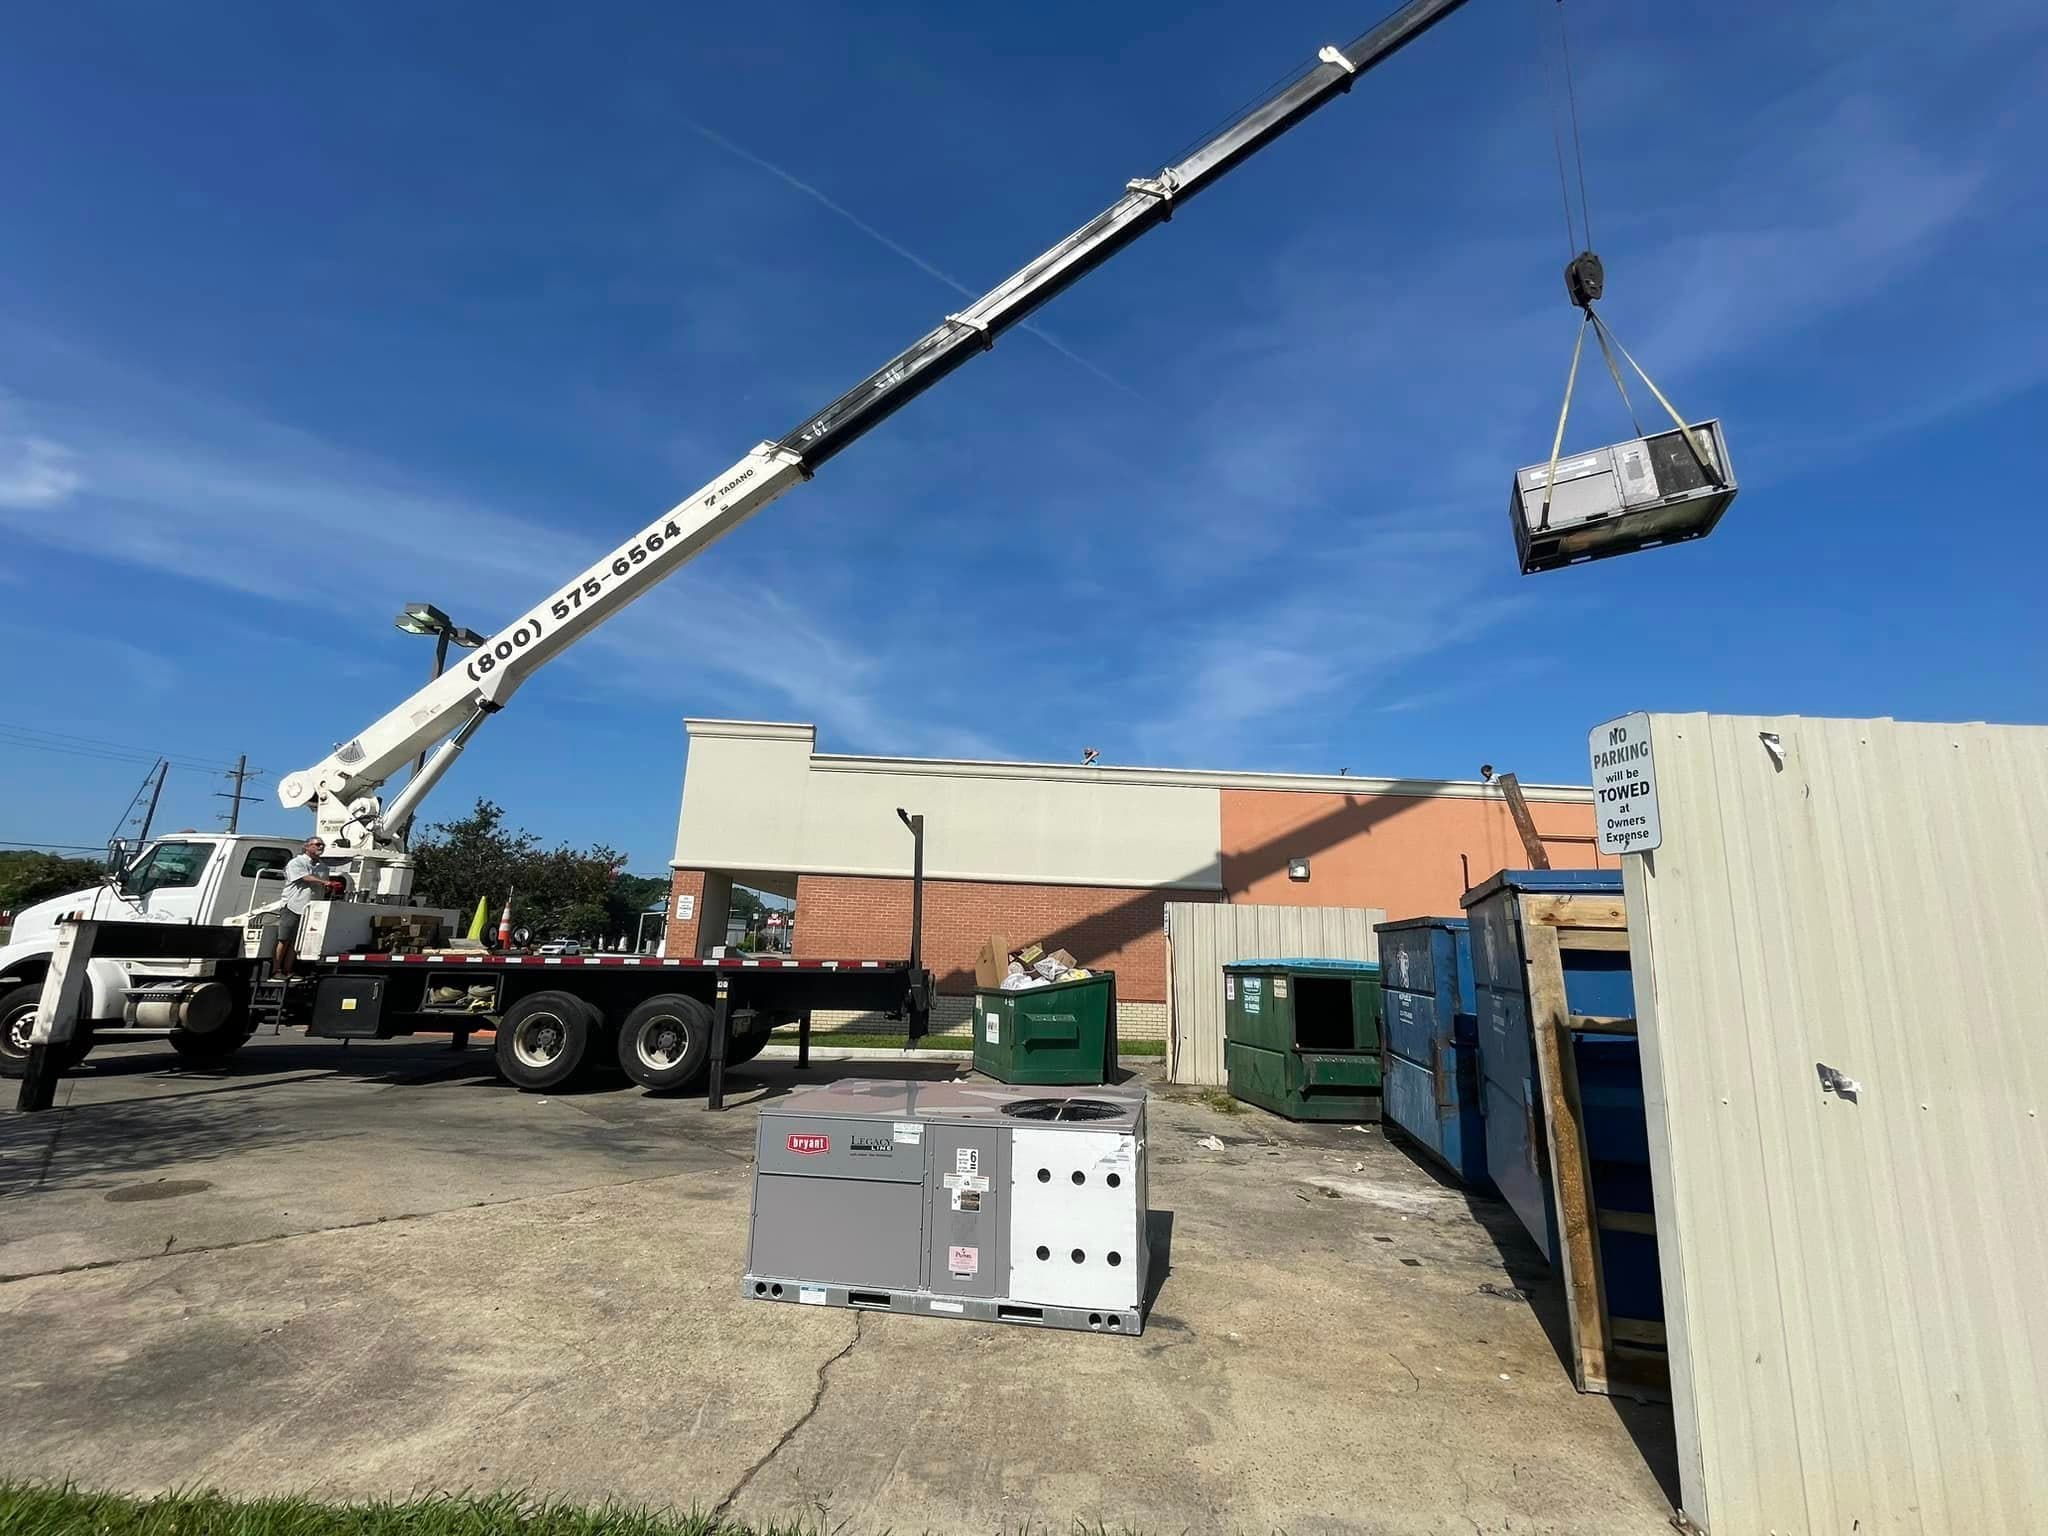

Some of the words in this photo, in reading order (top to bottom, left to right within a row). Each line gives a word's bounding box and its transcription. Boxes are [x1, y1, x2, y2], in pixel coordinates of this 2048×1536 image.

[812, 420, 828, 436] 62
[718, 469, 754, 496] TADANO
[467, 618, 542, 682] (800)
[551, 520, 682, 620] 575-6564
[1609, 727, 1627, 746] NO
[1593, 741, 1649, 769] PARKING
[1605, 771, 1623, 783] will
[1626, 769, 1639, 779] be
[1599, 781, 1650, 803] TOWED
[1619, 803, 1630, 813] at
[1607, 816, 1646, 829] Owners
[1606, 830, 1649, 844] Expense
[793, 1136, 824, 1150] bryant
[851, 1135, 891, 1146] LEGACY
